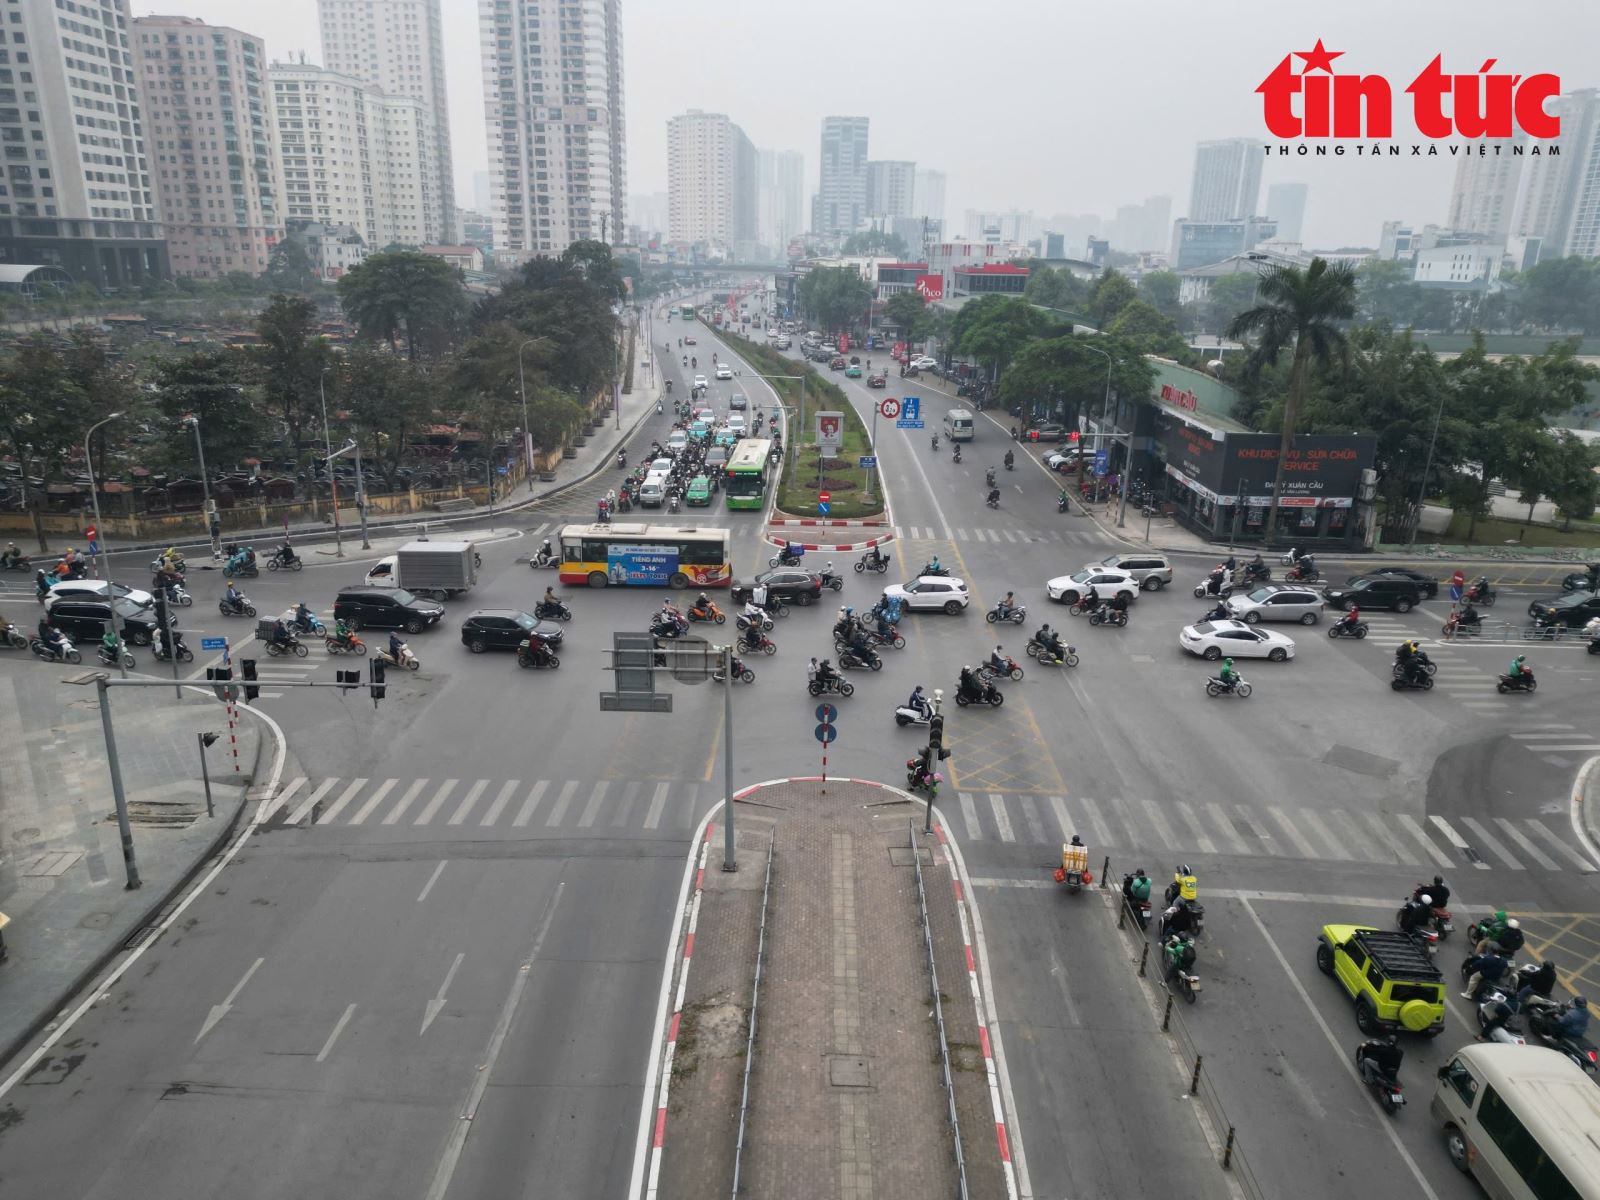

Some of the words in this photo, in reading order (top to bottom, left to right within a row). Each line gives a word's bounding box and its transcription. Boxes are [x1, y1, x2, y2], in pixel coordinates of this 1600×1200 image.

[923, 287, 942, 296] Pico
[1238, 450, 1258, 459] KHU
[1283, 461, 1320, 471] ERVICE
